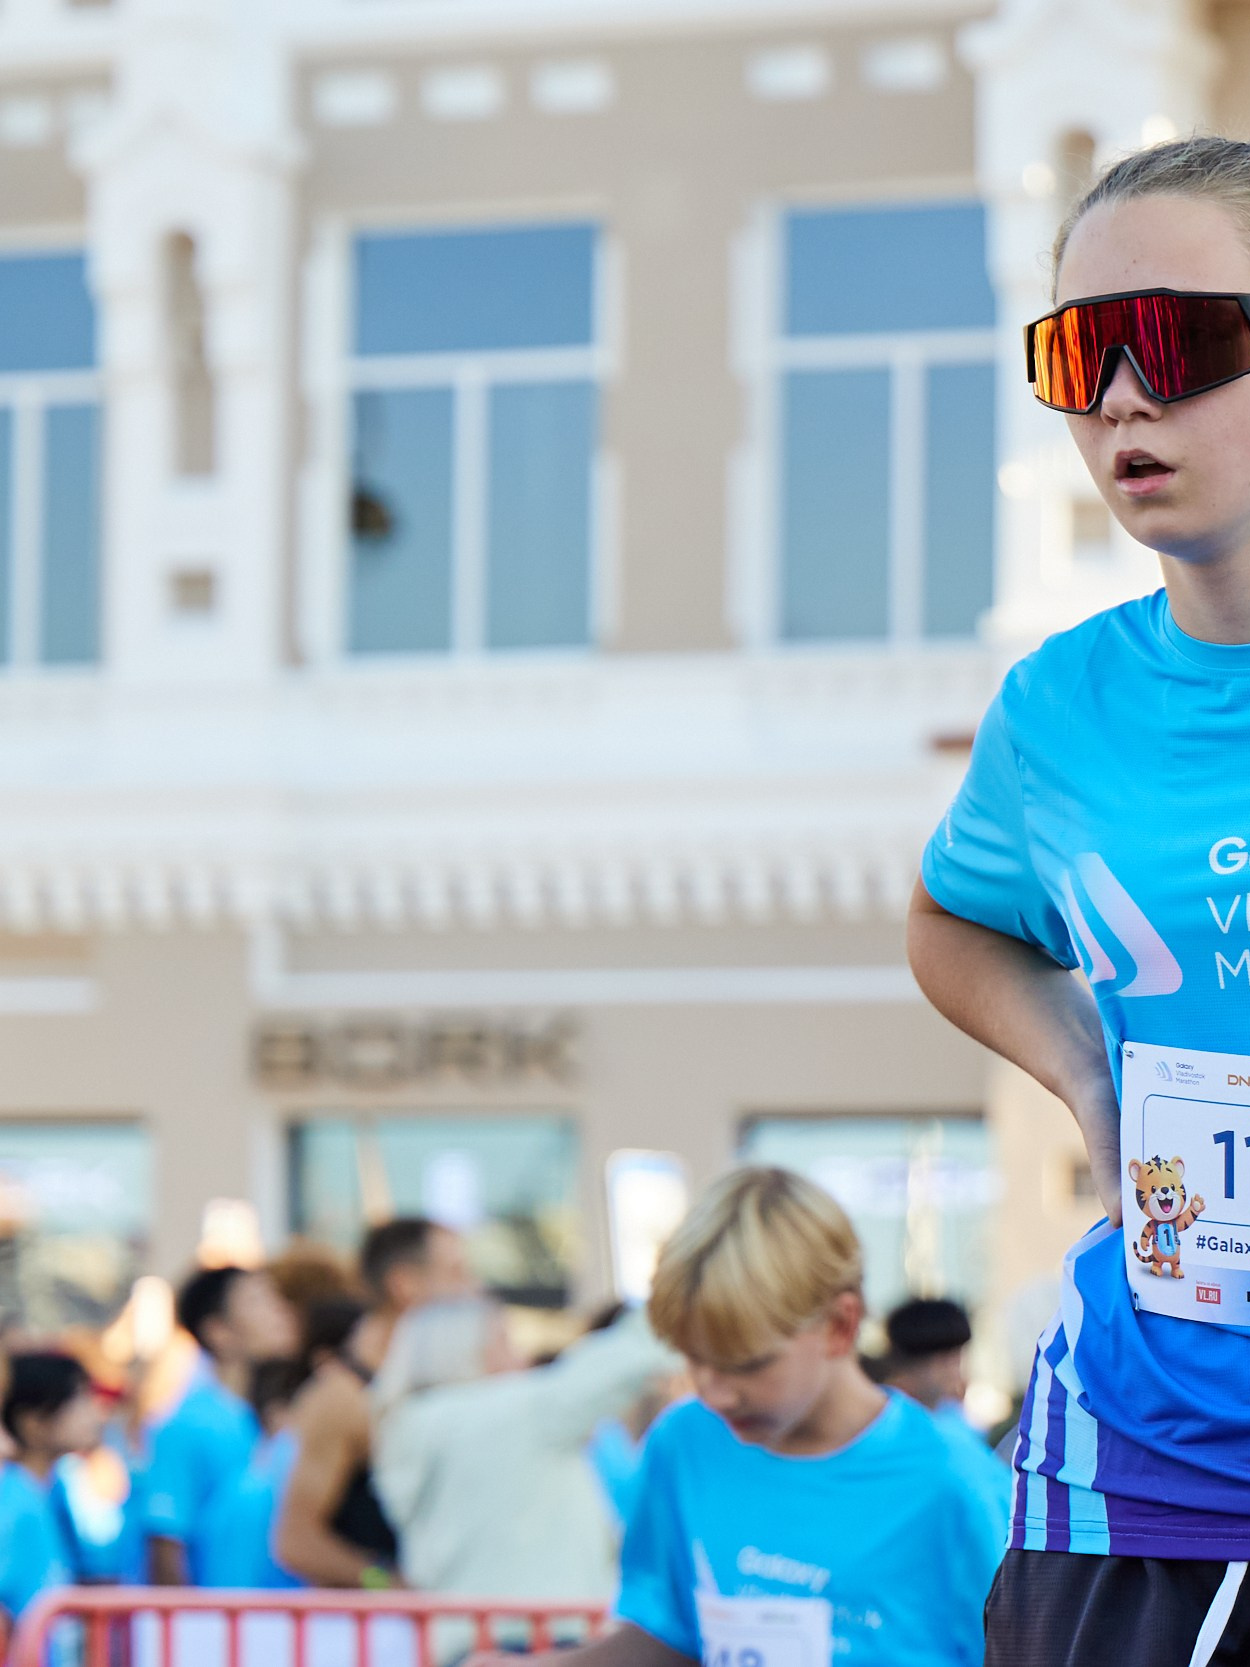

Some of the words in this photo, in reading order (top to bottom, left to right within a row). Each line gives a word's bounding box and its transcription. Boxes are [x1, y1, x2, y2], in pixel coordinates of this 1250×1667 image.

[1176, 1062, 1194, 1071] Galaxy
[1176, 1070, 1206, 1079] Vladivostok
[1176, 1077, 1200, 1085] Marathon
[1163, 1229, 1170, 1246] 1
